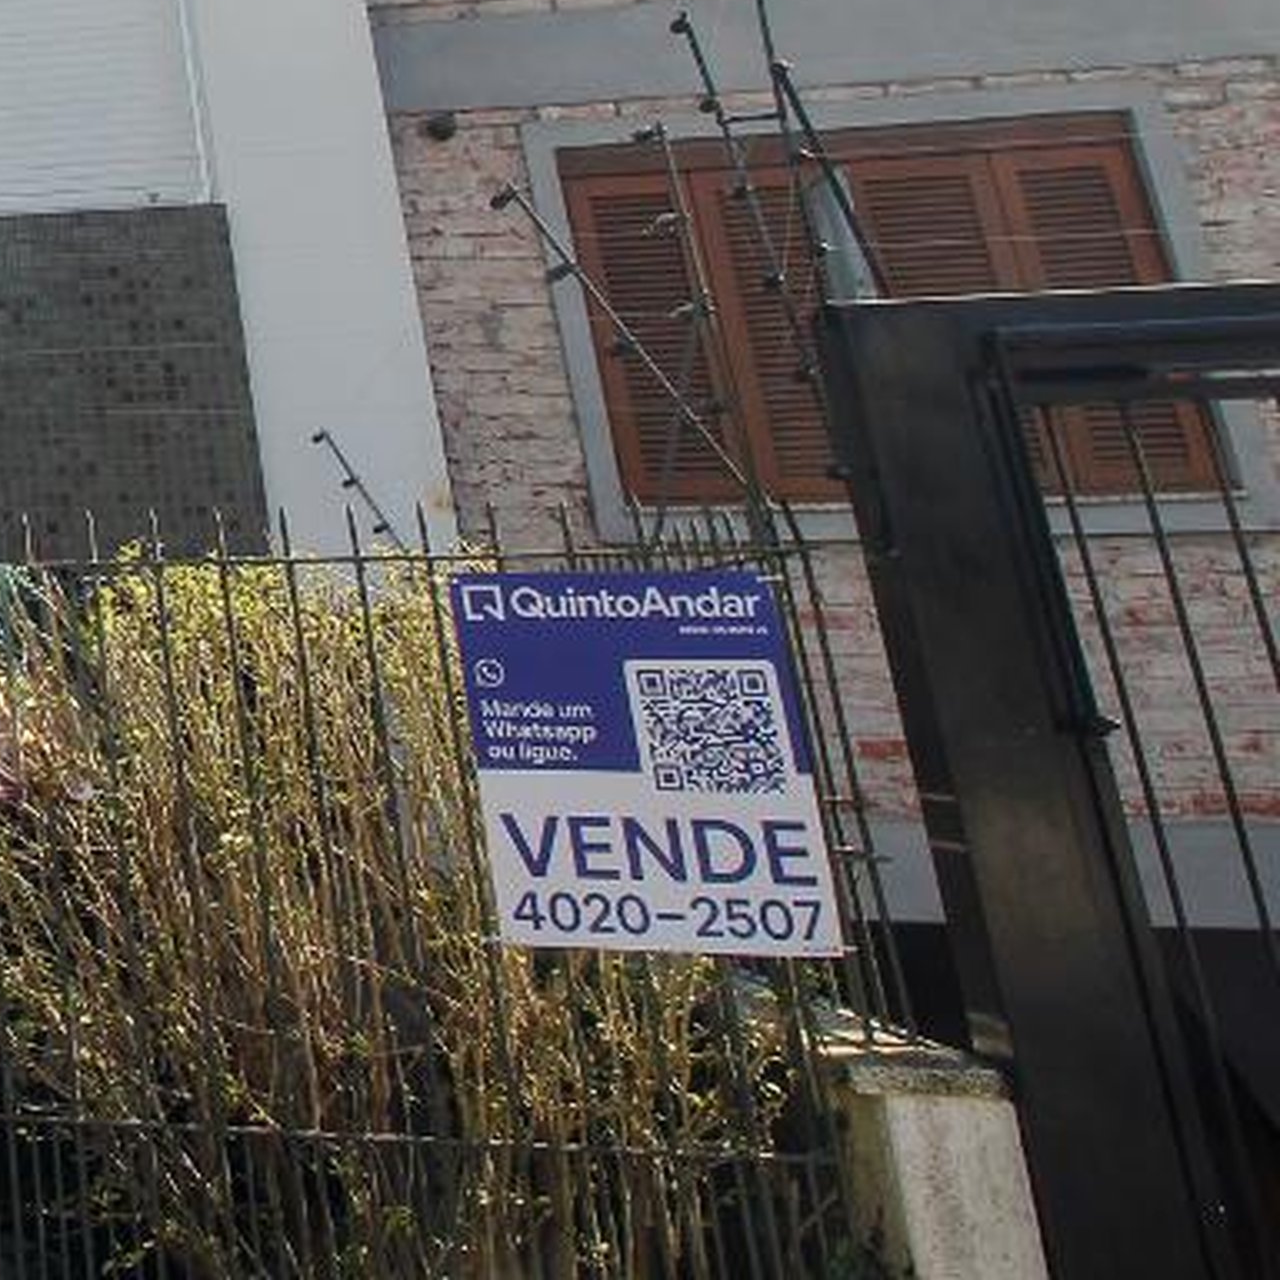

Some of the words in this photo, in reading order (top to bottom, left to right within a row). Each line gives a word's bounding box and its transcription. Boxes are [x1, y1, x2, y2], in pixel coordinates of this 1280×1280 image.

[511, 586, 761, 619] QuintoAndar
[481, 699, 555, 718] Mande
[559, 704, 593, 718] um
[482, 720, 598, 744] Whatsapp
[488, 745, 516, 759] ou
[520, 740, 579, 764] ligue.
[500, 813, 819, 887] VENDE
[512, 891, 822, 941] 4020-2507
